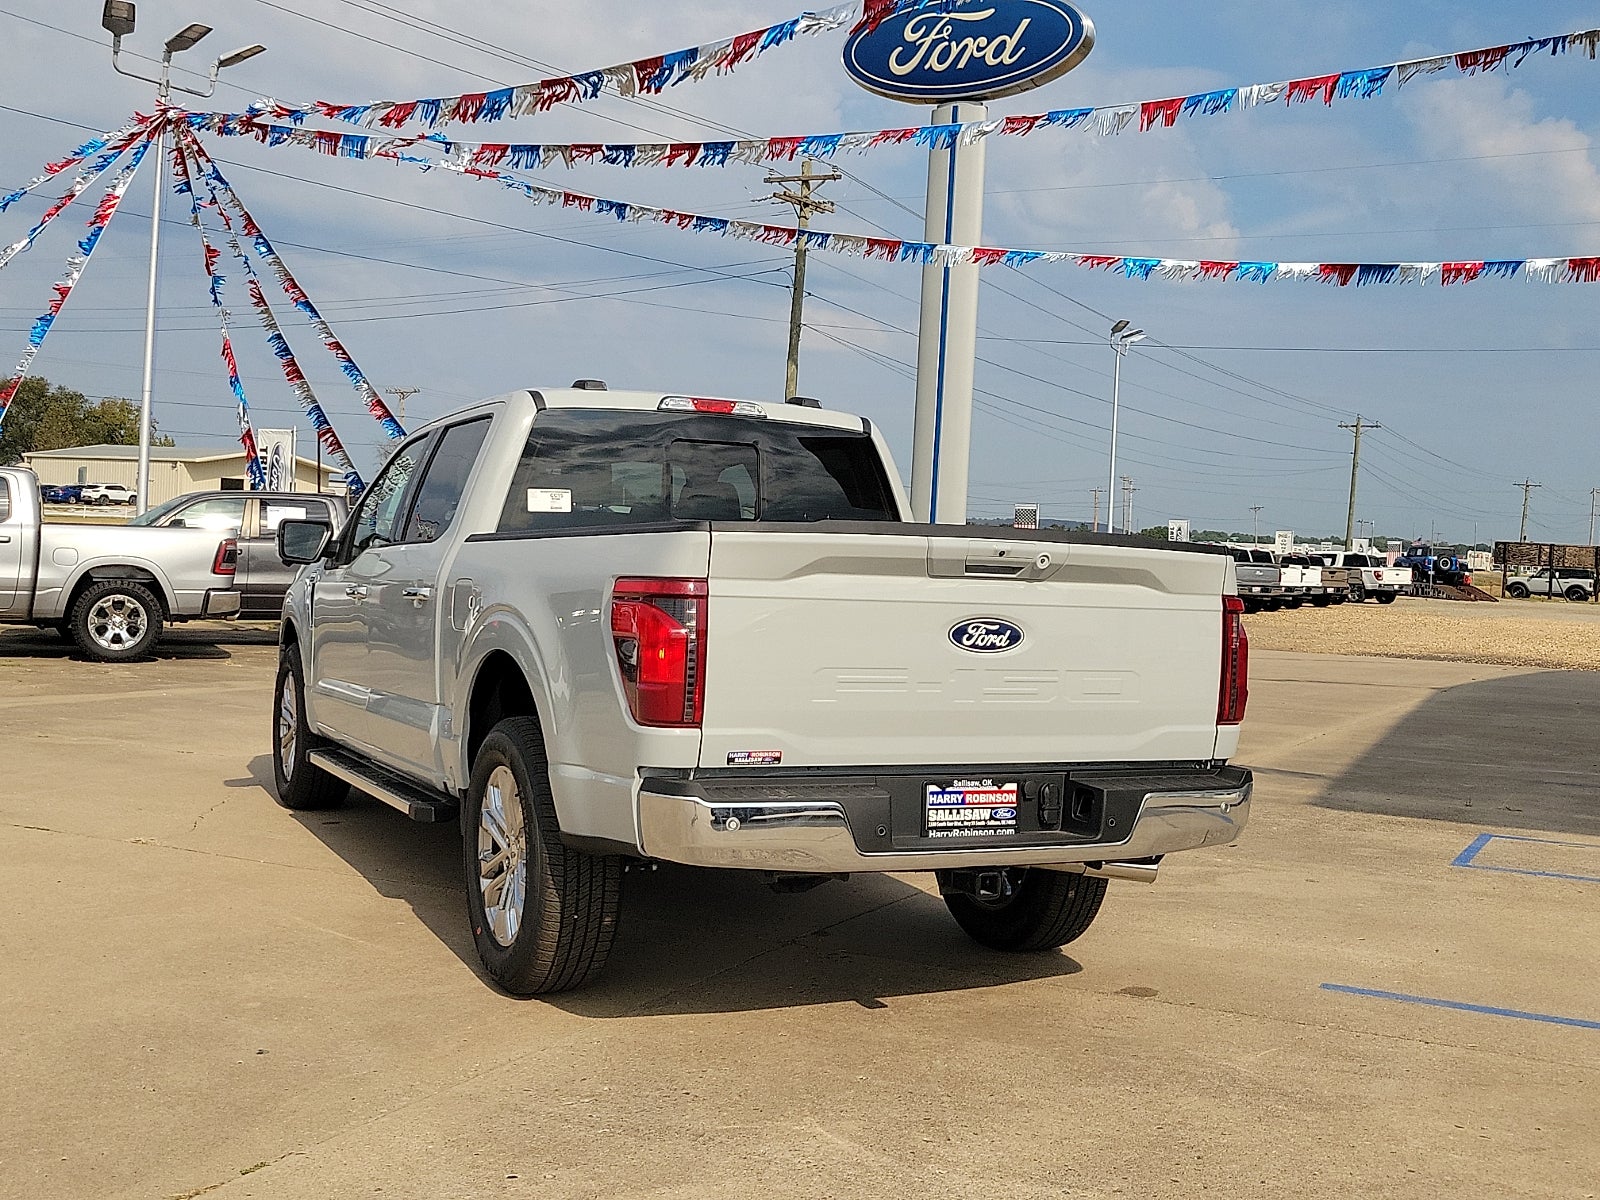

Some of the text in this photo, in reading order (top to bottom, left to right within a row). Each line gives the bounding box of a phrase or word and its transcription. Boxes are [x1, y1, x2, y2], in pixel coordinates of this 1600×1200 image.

[888, 8, 1031, 75] Ford
[962, 623, 1012, 648] Ford
[953, 779, 993, 788] Sallisaw, OK
[929, 793, 1017, 805] HARRY ROBINSON
[928, 808, 992, 821] SALLISAW
[928, 828, 1015, 838] HarryRobinson.com
